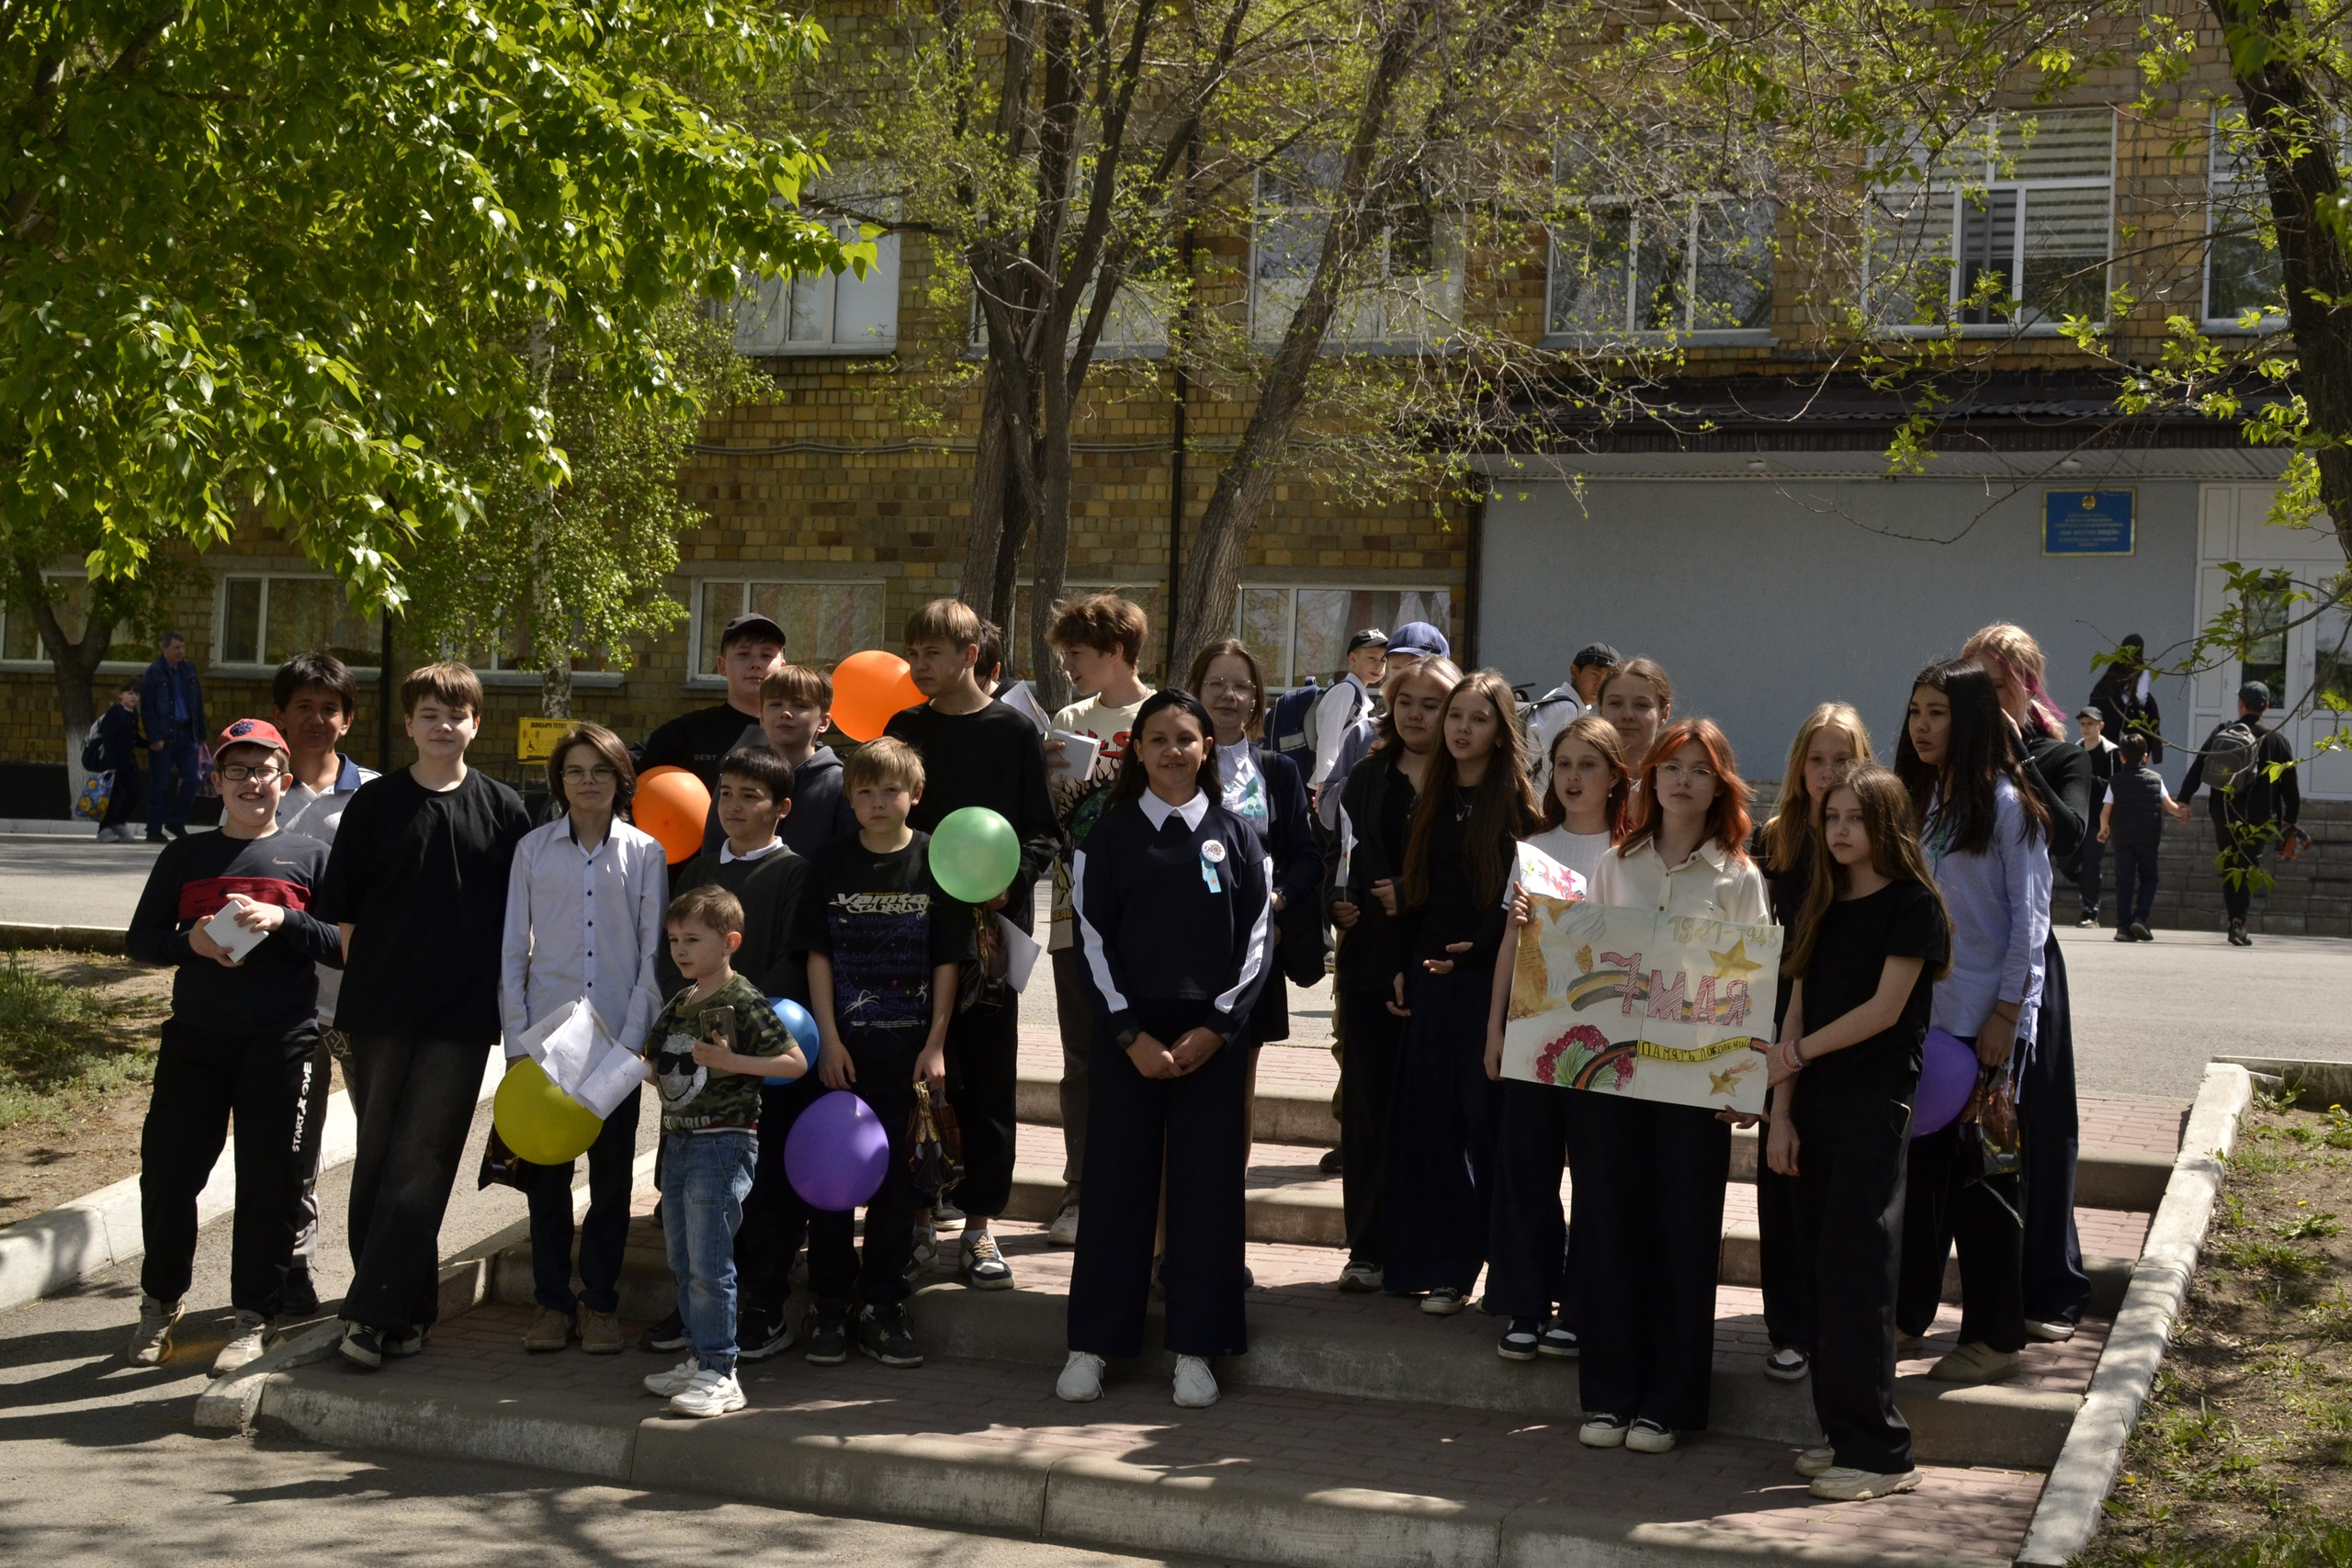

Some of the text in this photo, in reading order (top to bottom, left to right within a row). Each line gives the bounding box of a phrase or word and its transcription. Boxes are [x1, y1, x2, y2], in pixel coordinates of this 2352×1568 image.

[1668, 917, 1779, 948] 1941-1945
[1600, 952, 1644, 1015] 7
[1646, 969, 1749, 1027] МАЯ
[1642, 1038, 1751, 1062] ПАМЯТЬ ПОКОЛЕНИЙ
[292, 1112, 305, 1152] START
